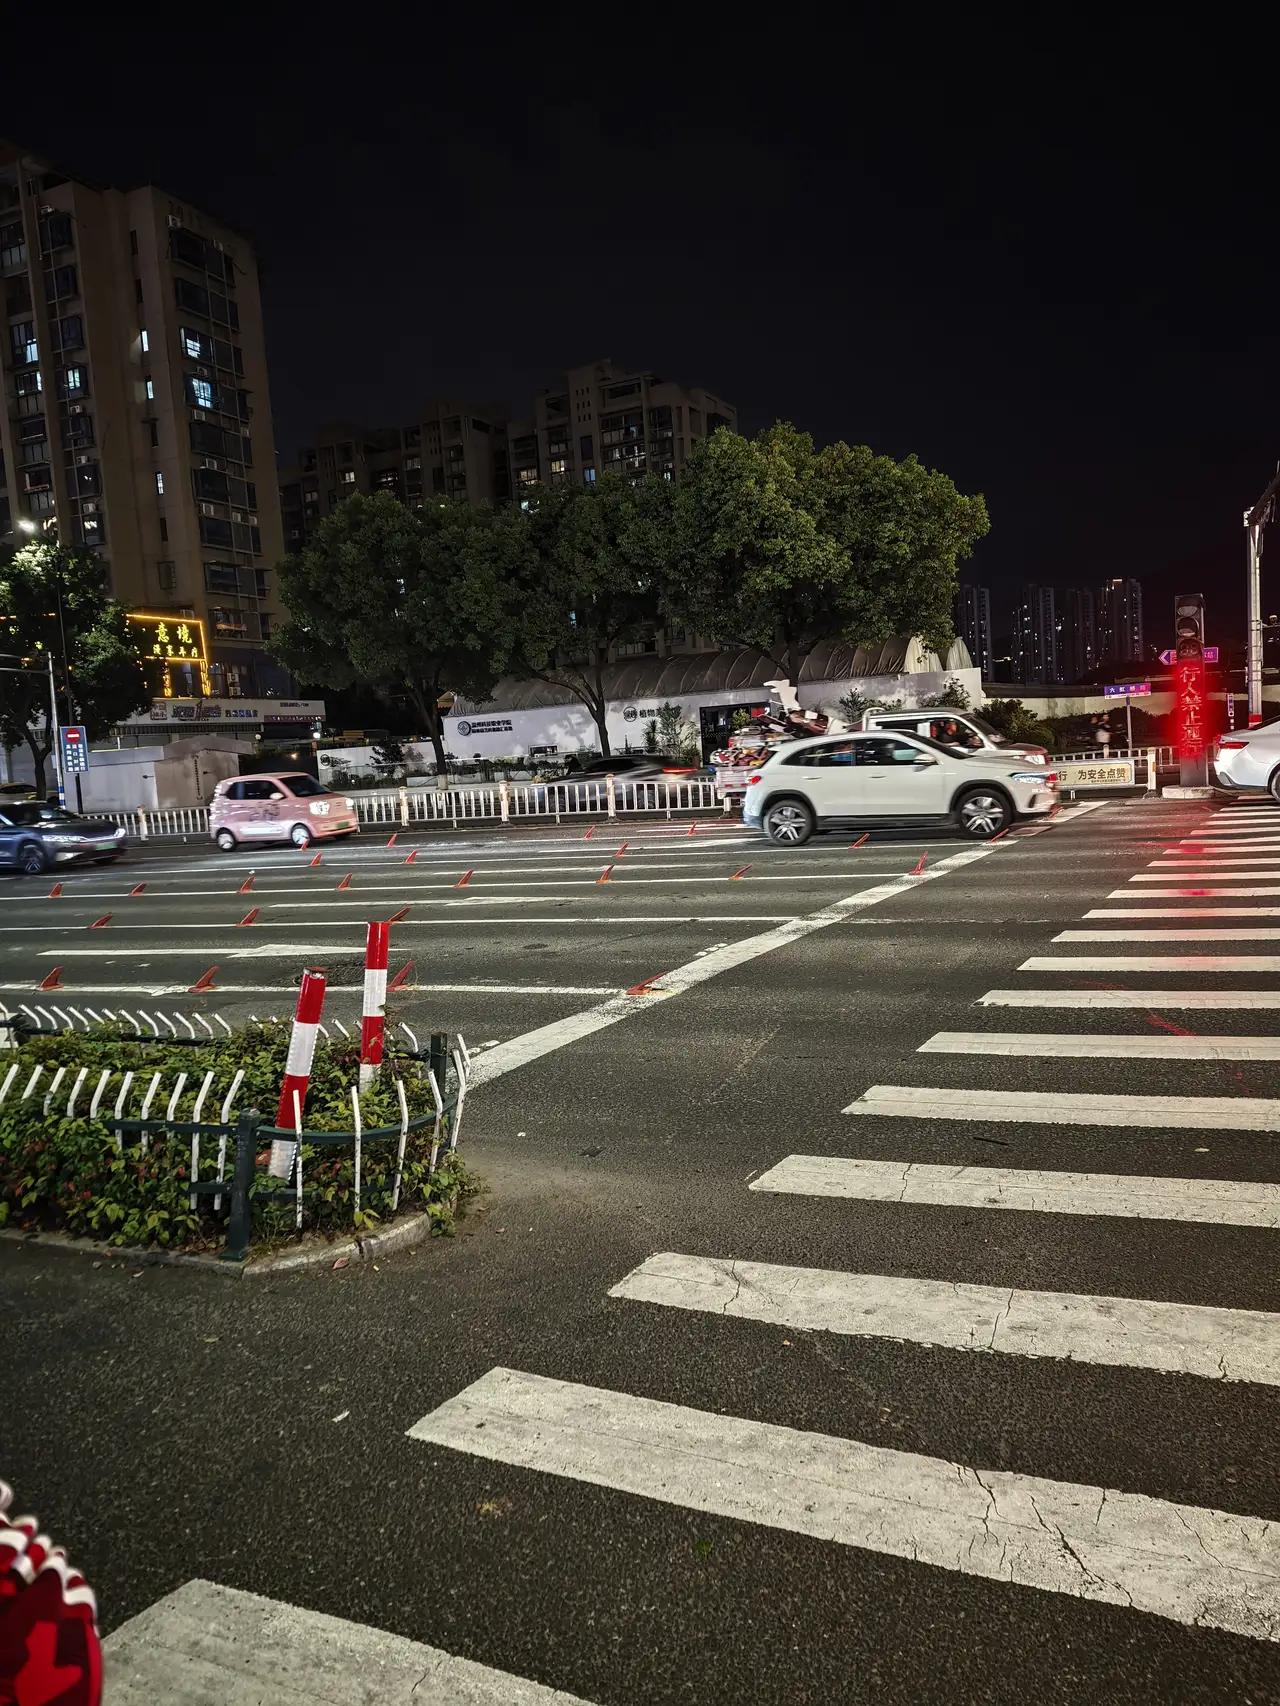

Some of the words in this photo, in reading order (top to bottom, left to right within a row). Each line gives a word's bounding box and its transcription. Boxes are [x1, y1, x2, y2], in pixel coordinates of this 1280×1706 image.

[155, 621, 193, 644] 意境
[1179, 666, 1203, 755] 行人禁止通行
[1078, 767, 1126, 780] 为安全点赞
